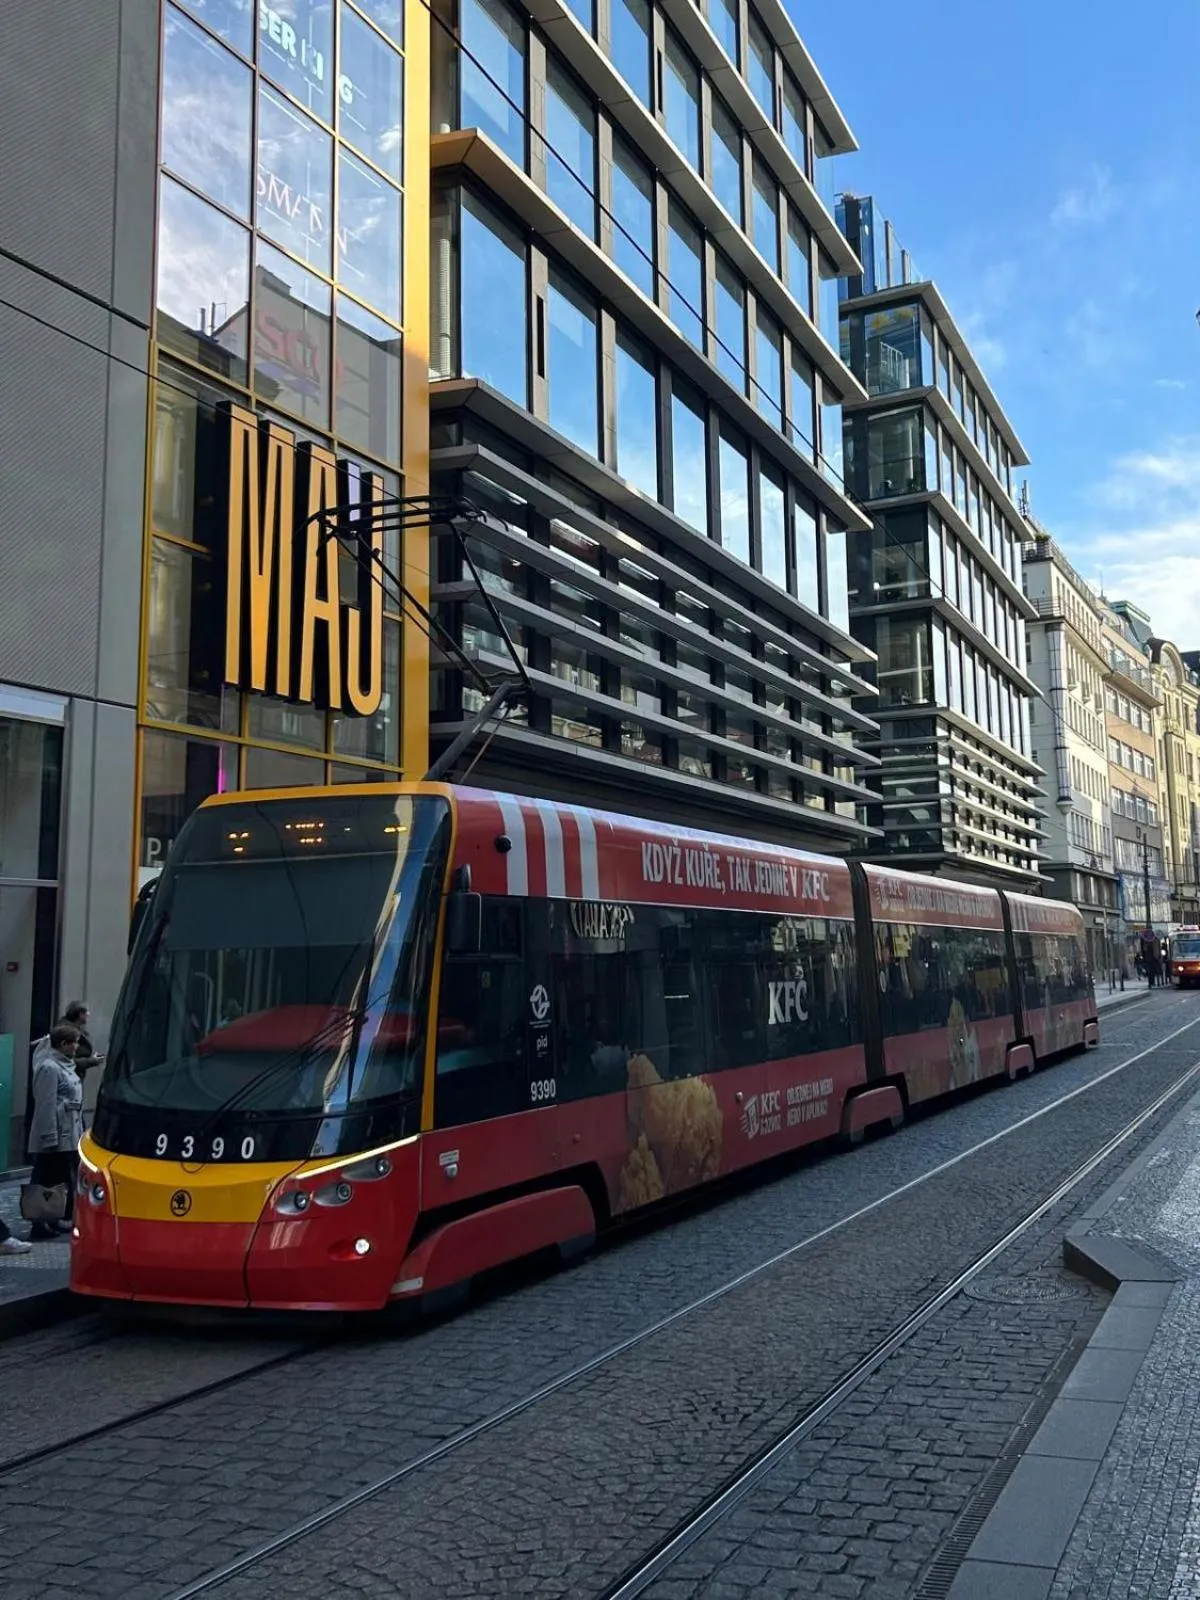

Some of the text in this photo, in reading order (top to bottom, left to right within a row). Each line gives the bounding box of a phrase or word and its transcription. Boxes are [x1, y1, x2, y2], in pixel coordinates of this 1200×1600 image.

[641, 837, 684, 885] KDYŽ
[685, 841, 727, 896] KUŘE,
[727, 856, 752, 893] TAK
[789, 866, 798, 898] V
[801, 869, 830, 902] KFC
[768, 980, 809, 1025] KFC
[530, 1079, 556, 1101] 9390
[761, 1090, 780, 1116] KFC
[155, 1133, 255, 1159] 9390
